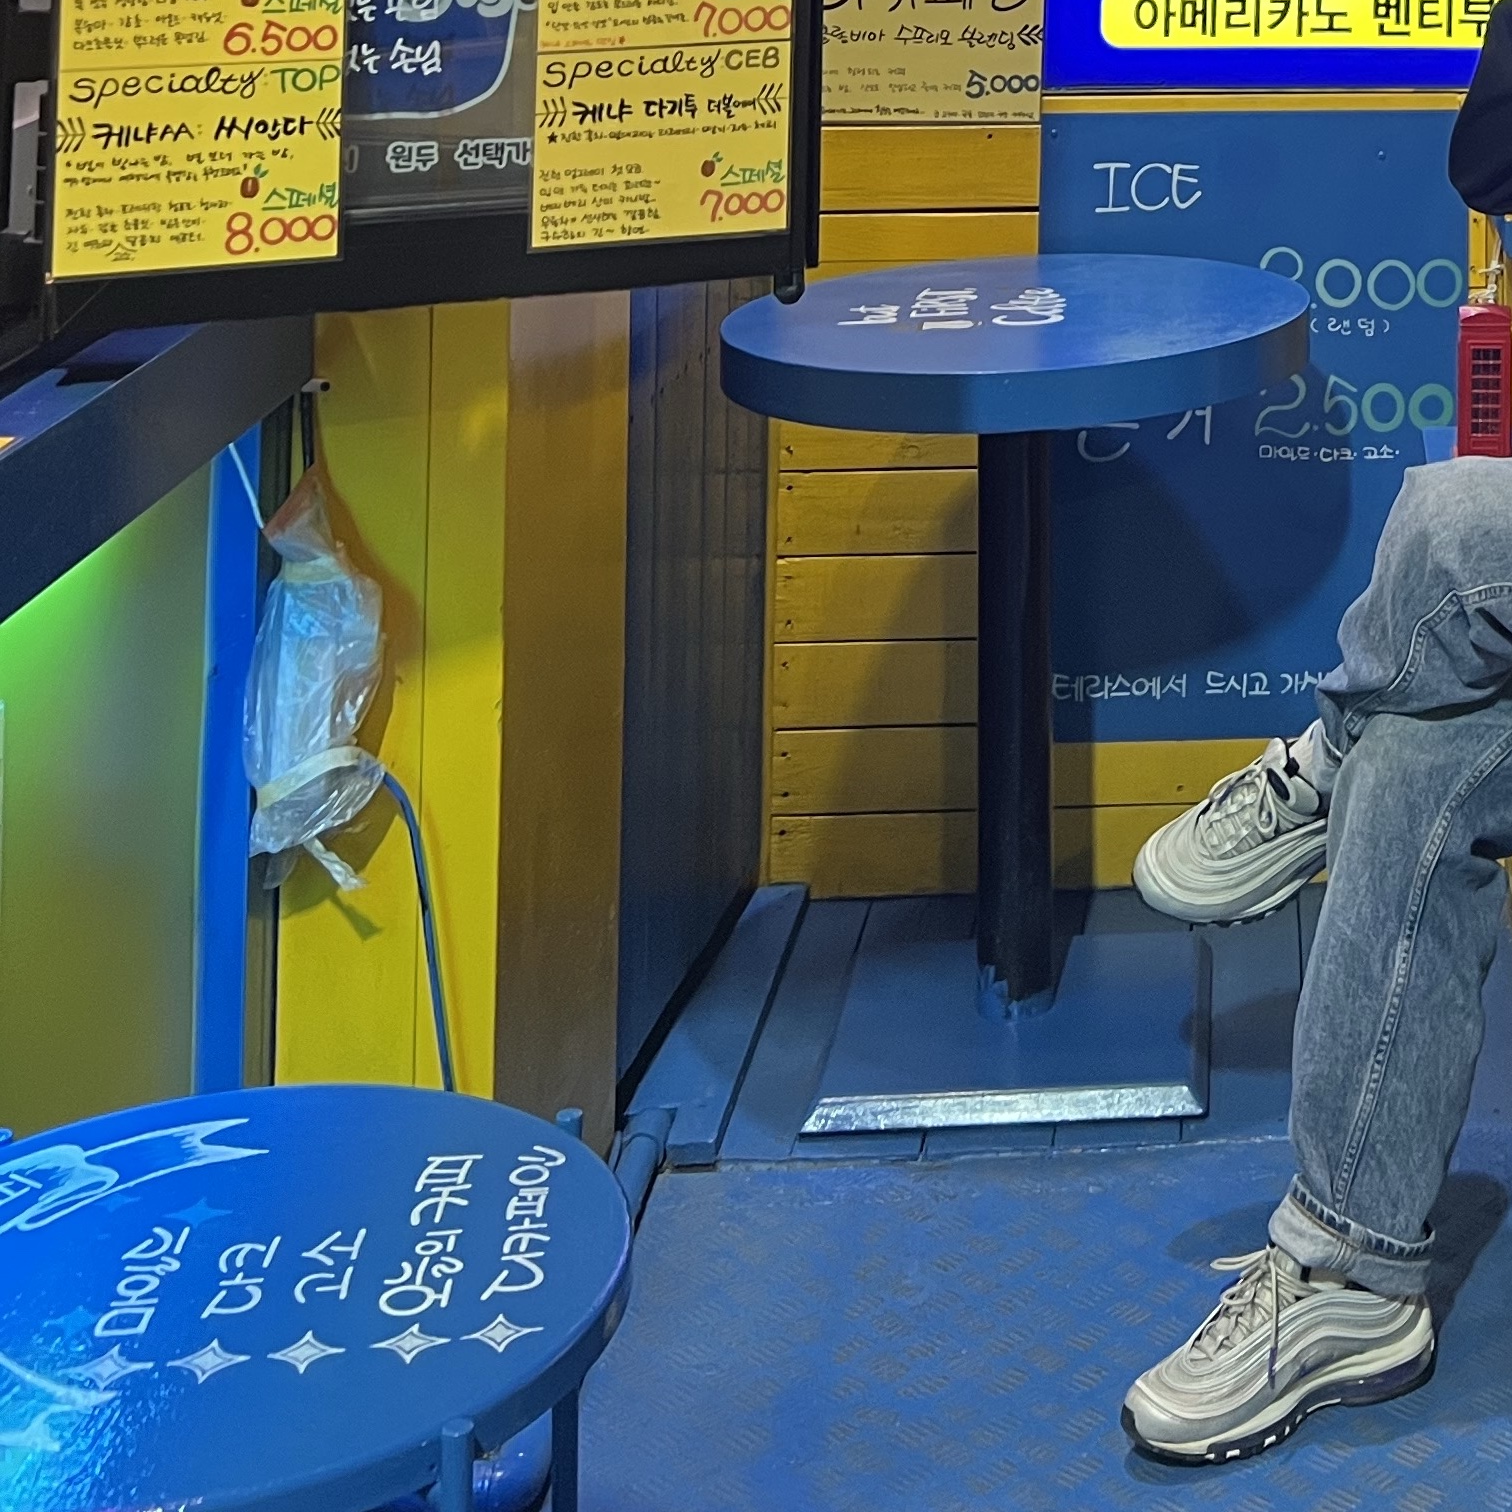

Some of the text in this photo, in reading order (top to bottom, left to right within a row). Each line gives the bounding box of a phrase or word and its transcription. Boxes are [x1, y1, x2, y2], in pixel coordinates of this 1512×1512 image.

[694, 1, 791, 38] 7.000
[223, 23, 339, 56] 6.500
[894, 24, 1015, 50] 수프리모 블렌딩
[270, 65, 340, 94] TOP
[965, 69, 1039, 98] 5.000
[386, 141, 440, 173] 원두
[720, 159, 786, 186] 스페셜
[1093, 161, 1202, 214] ICE
[262, 182, 340, 211] 스페셜
[700, 189, 786, 222] 7.000
[225, 212, 338, 255] 8.000
[1310, 316, 1391, 337] (랜덤)
[1254, 374, 1455, 439] 2.500
[1052, 673, 1271, 702] 테라스에서 드시고
